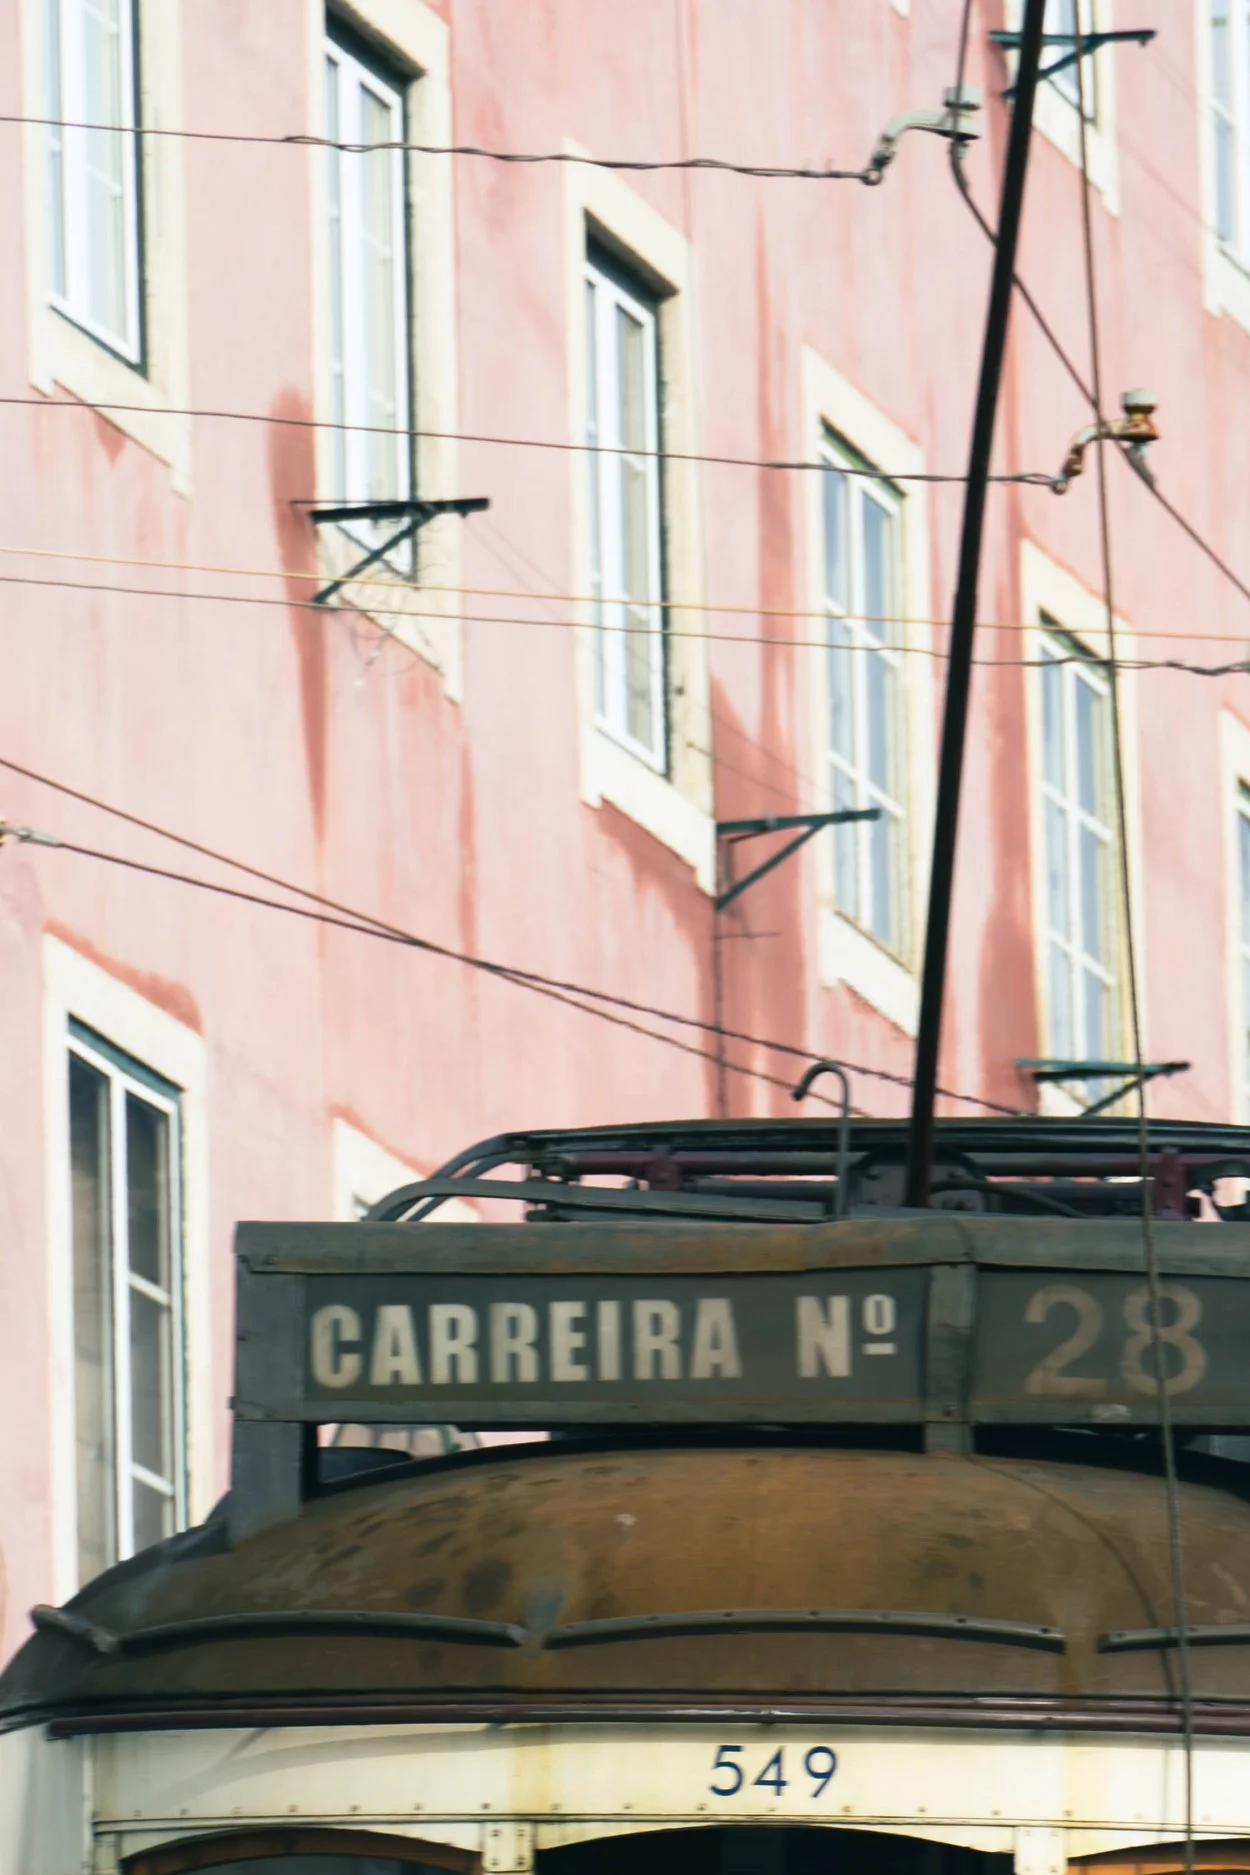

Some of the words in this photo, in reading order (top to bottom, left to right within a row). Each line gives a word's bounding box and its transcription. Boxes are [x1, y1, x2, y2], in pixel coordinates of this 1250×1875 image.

[309, 1296, 744, 1388] CARREIRA
[1022, 1282, 1206, 1396] 28
[709, 1744, 837, 1798] 549
